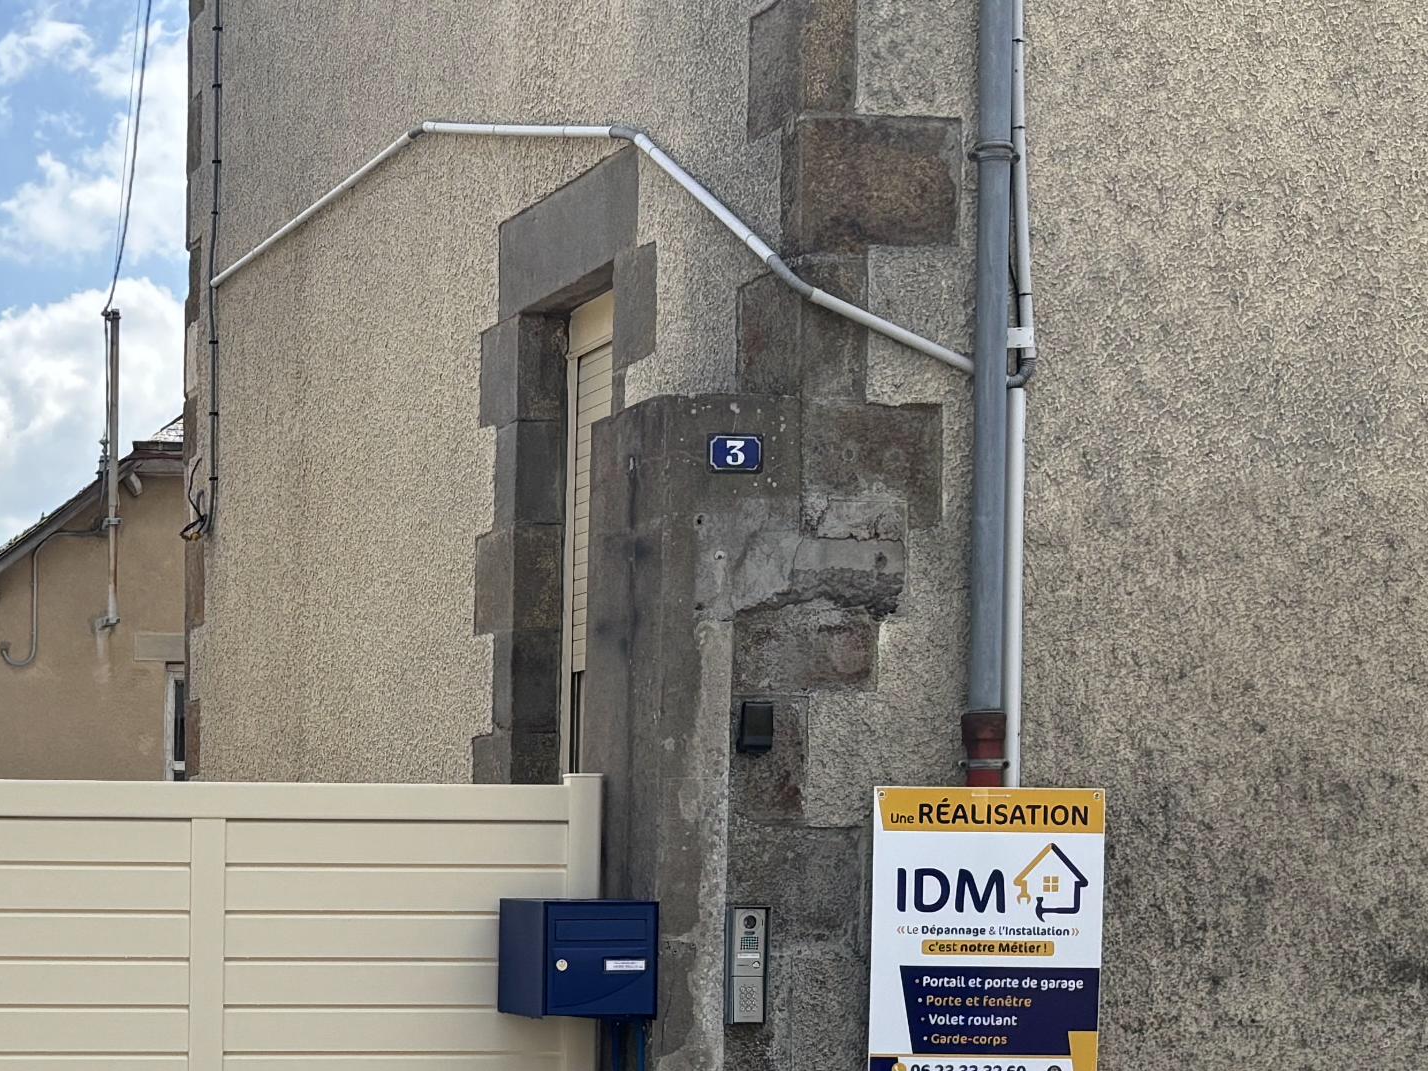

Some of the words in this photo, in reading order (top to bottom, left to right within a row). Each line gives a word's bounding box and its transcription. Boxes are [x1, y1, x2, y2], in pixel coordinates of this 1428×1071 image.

[726, 440, 745, 465] 3
[890, 812, 915, 824] Une
[918, 798, 1089, 826] RÉALISATION
[896, 867, 1006, 914] IDM
[921, 924, 986, 937] Dépannage
[988, 926, 997, 936] &
[998, 926, 1070, 936] l'Installation
[928, 941, 957, 952] c'est
[960, 942, 995, 953] notre
[998, 941, 1041, 953] Métier
[922, 975, 966, 988] Portail
[968, 977, 981, 988] et
[983, 977, 1019, 990] porte
[1021, 976, 1038, 989] de
[1040, 978, 1084, 991] garage
[926, 994, 962, 1006] Porte
[965, 996, 980, 1007] et
[983, 995, 1033, 1008] fenêtre
[928, 1013, 965, 1026] Volet
[967, 1014, 1018, 1026] roulant
[930, 1033, 1008, 1047] Garde-corps
